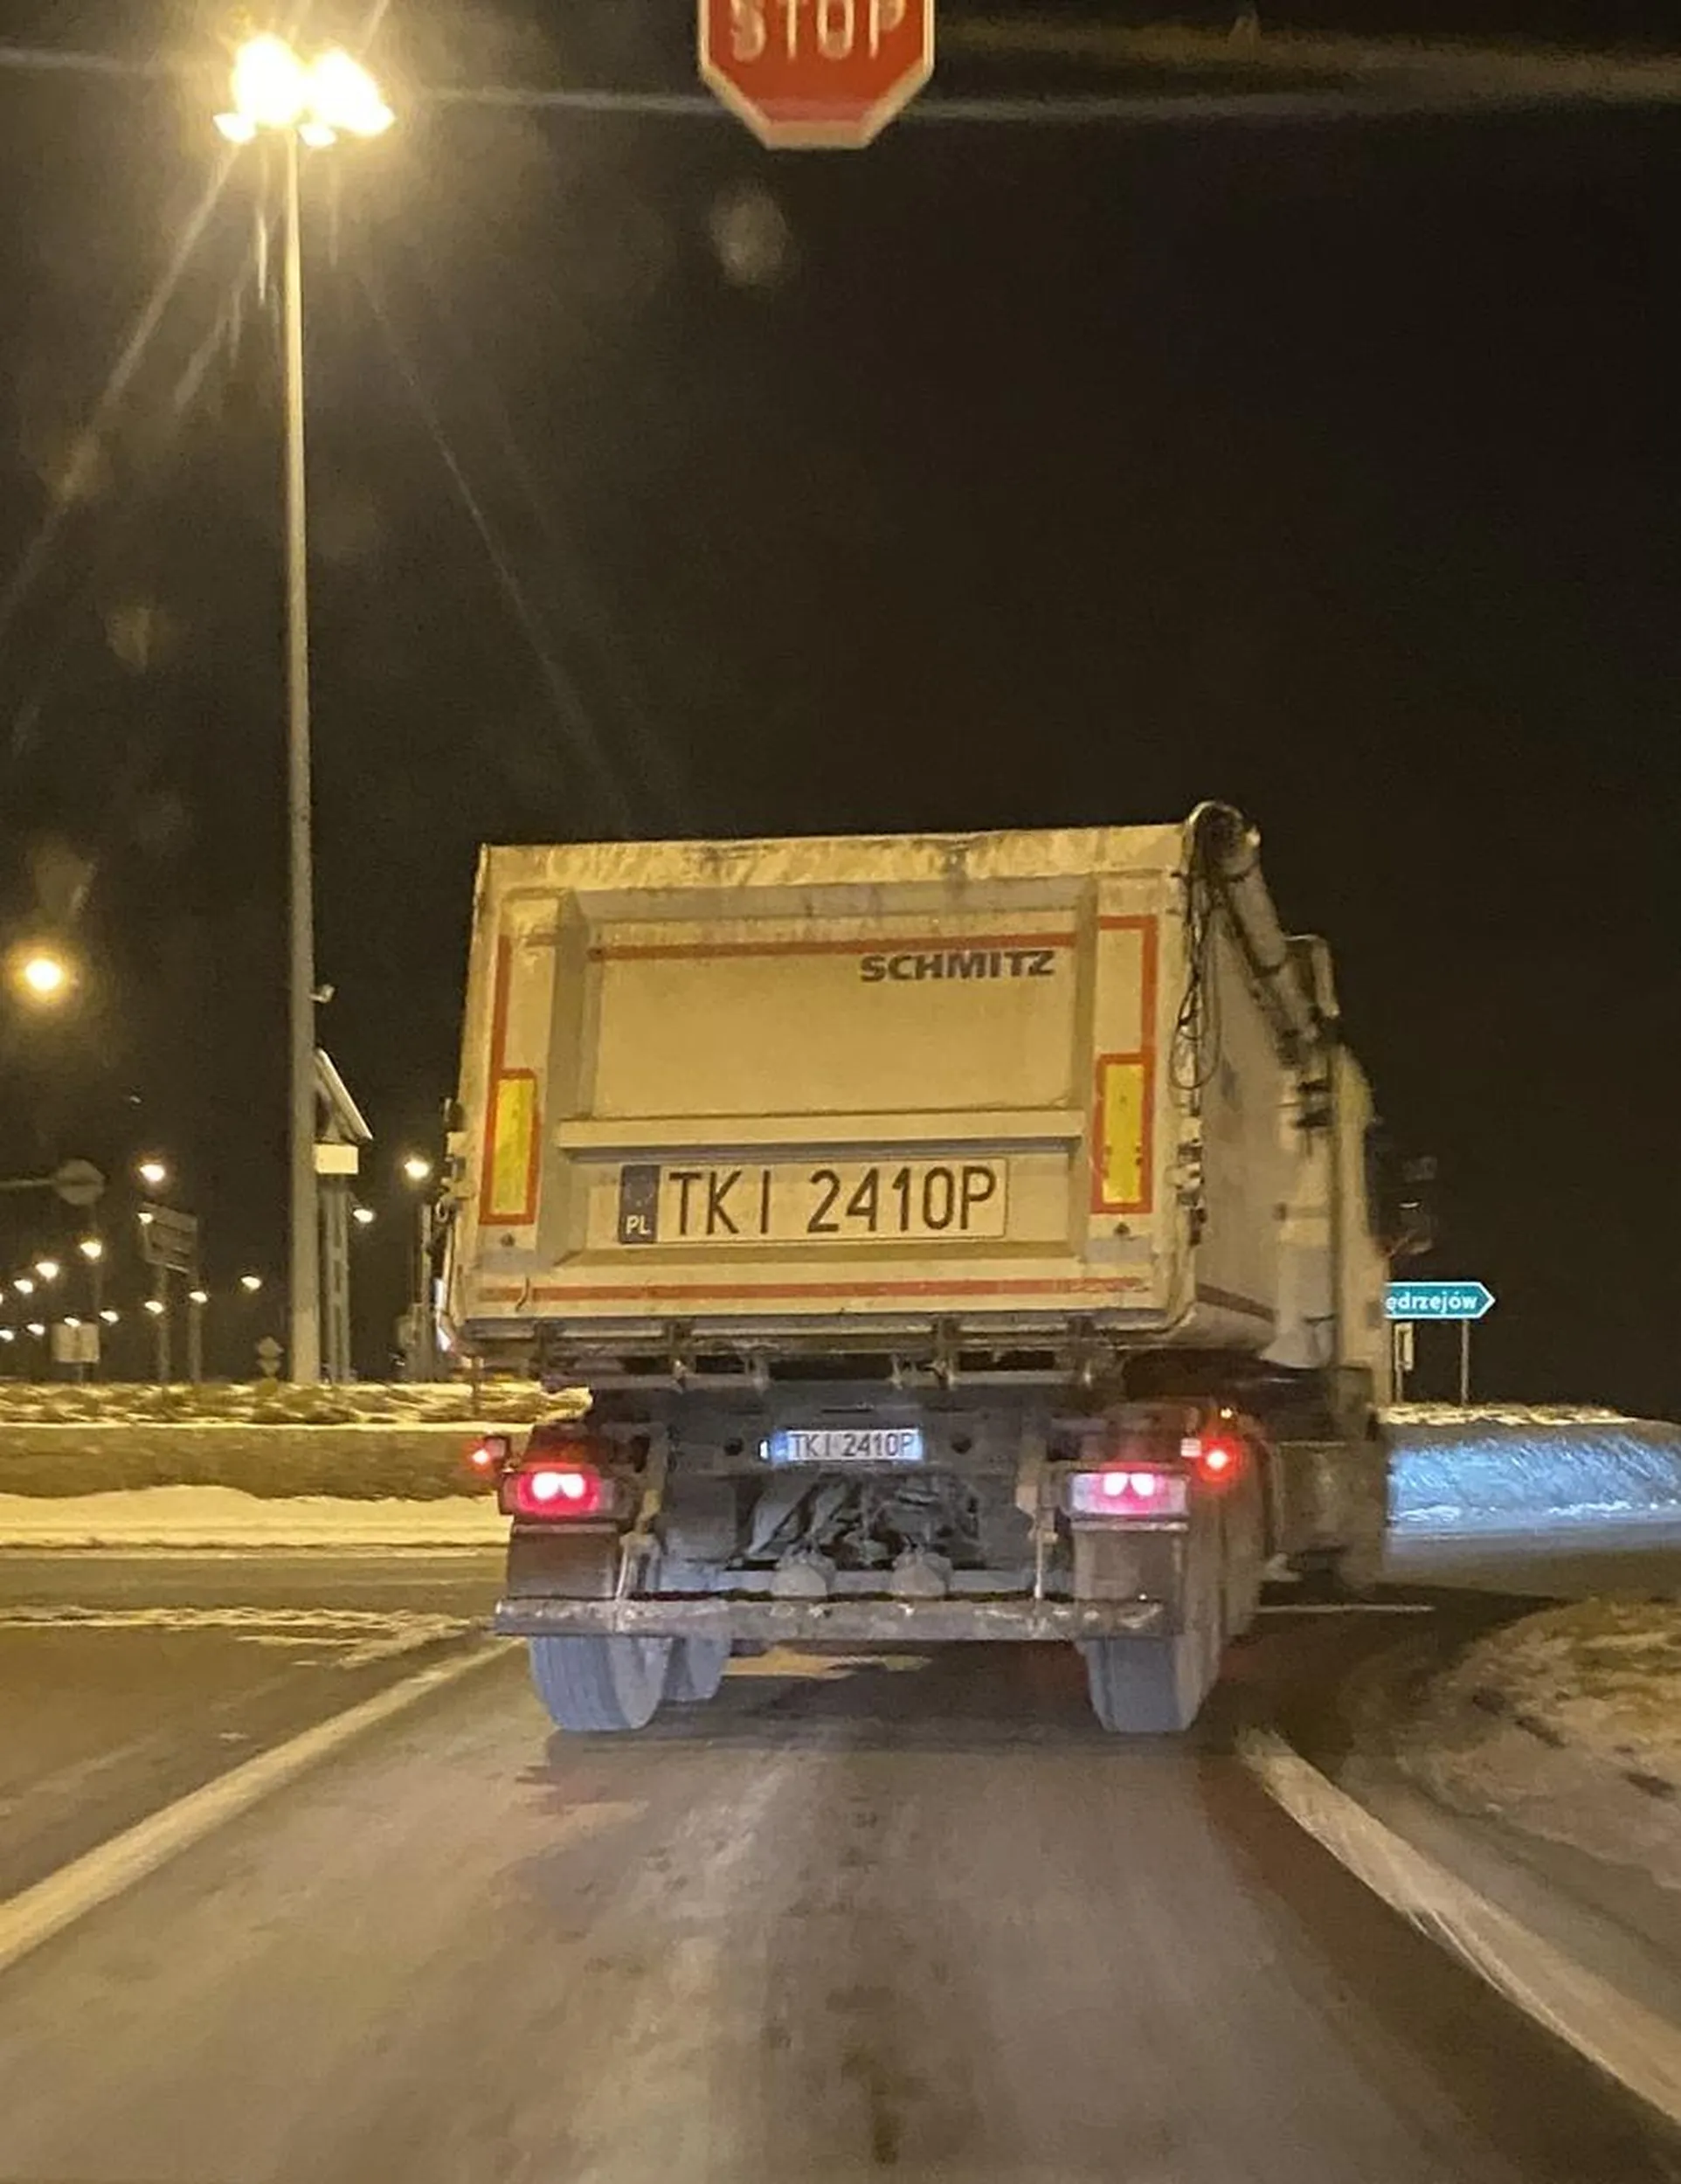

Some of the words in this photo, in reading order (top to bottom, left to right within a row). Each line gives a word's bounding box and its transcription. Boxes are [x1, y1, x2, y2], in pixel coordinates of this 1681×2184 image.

[730, 0, 905, 62] STOP
[861, 950, 1055, 982] SCHMITZ
[668, 1171, 771, 1235] TKI
[806, 1165, 996, 1234] 2410P
[626, 1216, 652, 1235] PL
[1385, 1290, 1478, 1315] ędrzejów
[842, 1433, 913, 1456] 2410P
